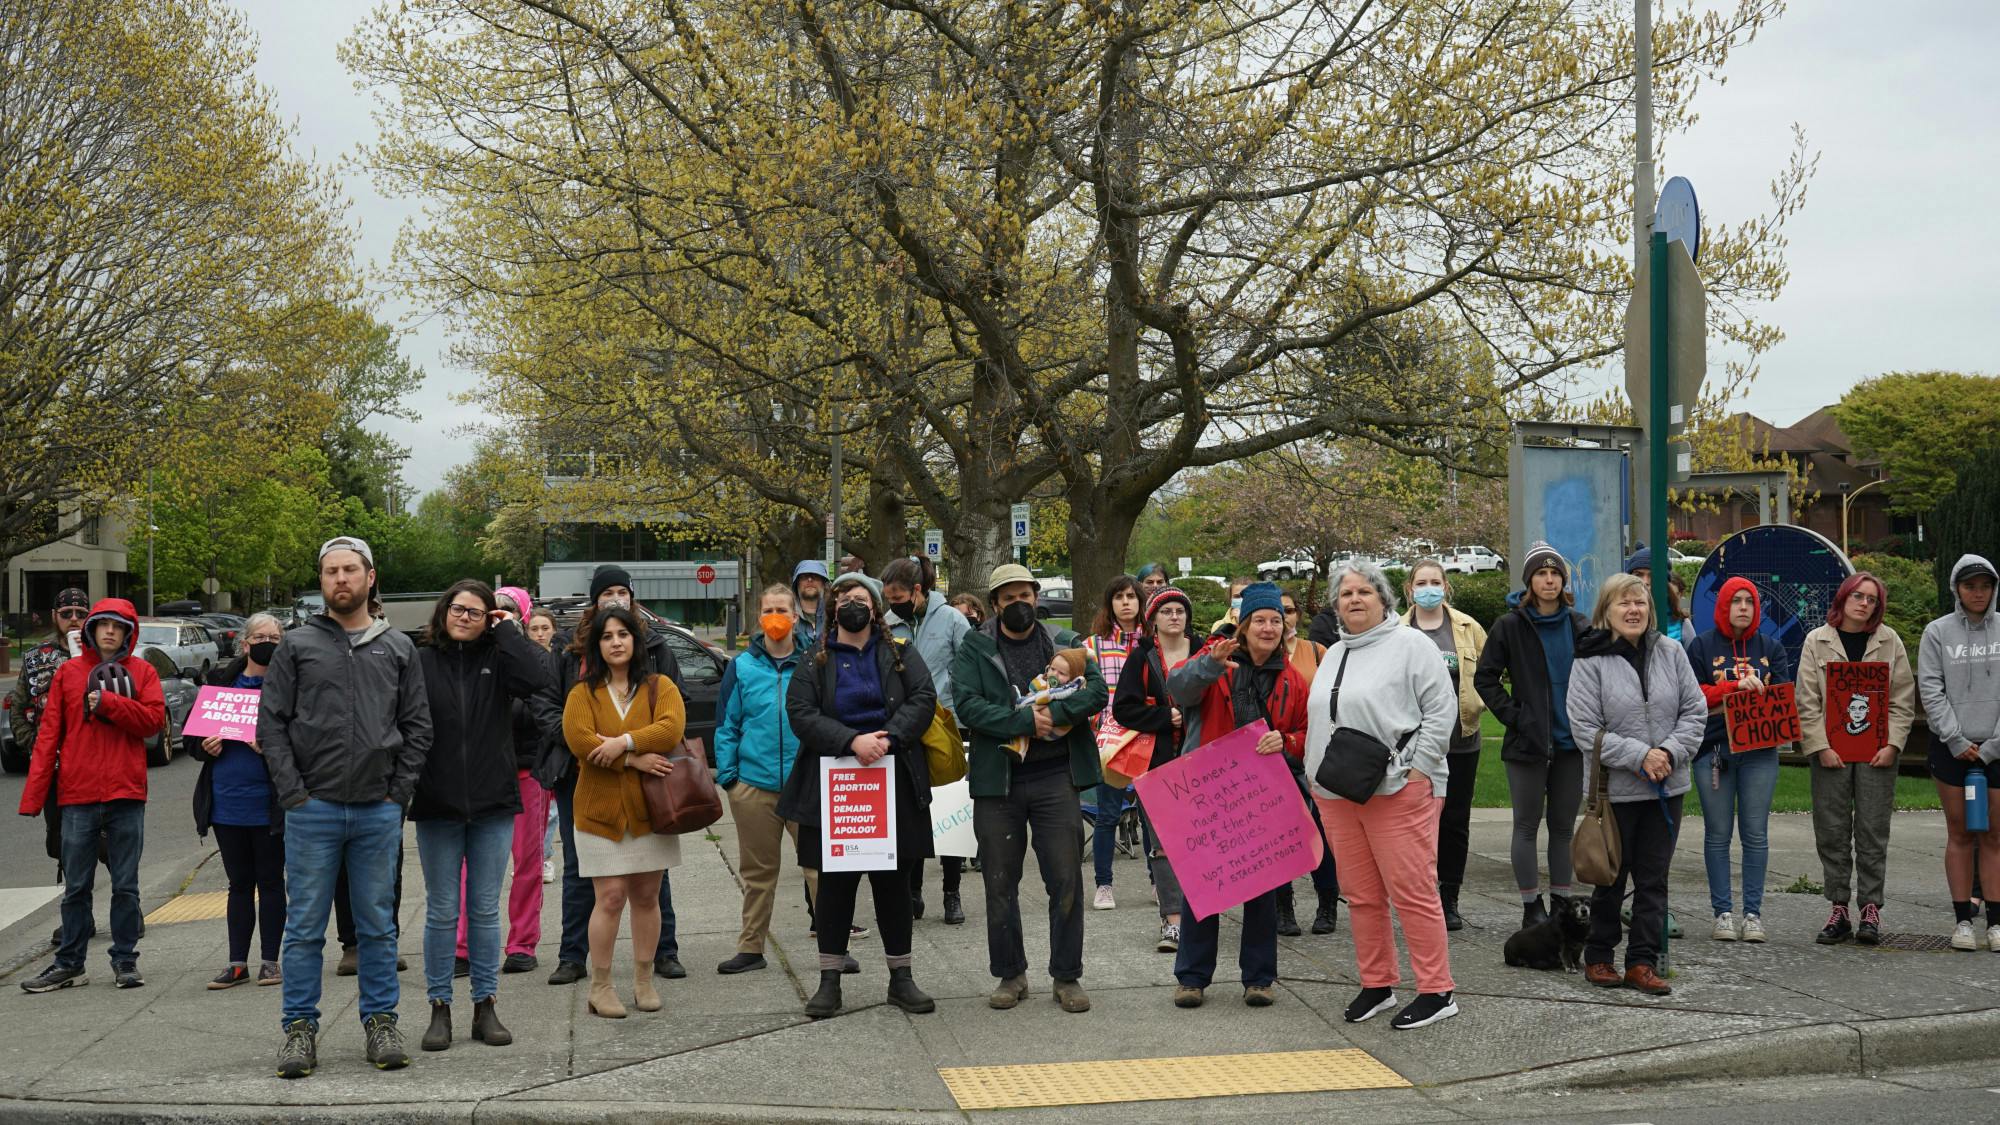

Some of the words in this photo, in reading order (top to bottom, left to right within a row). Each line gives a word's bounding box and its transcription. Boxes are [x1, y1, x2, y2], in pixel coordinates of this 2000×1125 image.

[698, 571, 714, 579] STOP
[1828, 662, 1889, 682] HANDS
[1835, 678, 1863, 692] OFF
[1726, 690, 1758, 709] GIVE
[1763, 686, 1787, 704] ME
[201, 700, 237, 714] SAFE,
[1734, 705, 1766, 724] BACK
[1770, 702, 1791, 718] MY
[1731, 714, 1800, 746] CHOICE
[832, 773, 856, 781] FREE
[1161, 757, 1239, 801] Women's
[833, 783, 880, 792] ABORTION
[1190, 780, 1240, 810] Right
[1244, 772, 1259, 784] to
[833, 794, 847, 803] ON
[833, 804, 873, 813] DEMAND
[833, 815, 876, 824] WITHOUT
[833, 826, 877, 835] APOLOGY
[1217, 824, 1267, 855] Bodies
[1203, 865, 1224, 881] NOT
[1229, 853, 1248, 869] THE
[1250, 834, 1285, 858] CHOICE
[1217, 879, 1225, 892] A
[1229, 856, 1274, 882] STACKED
